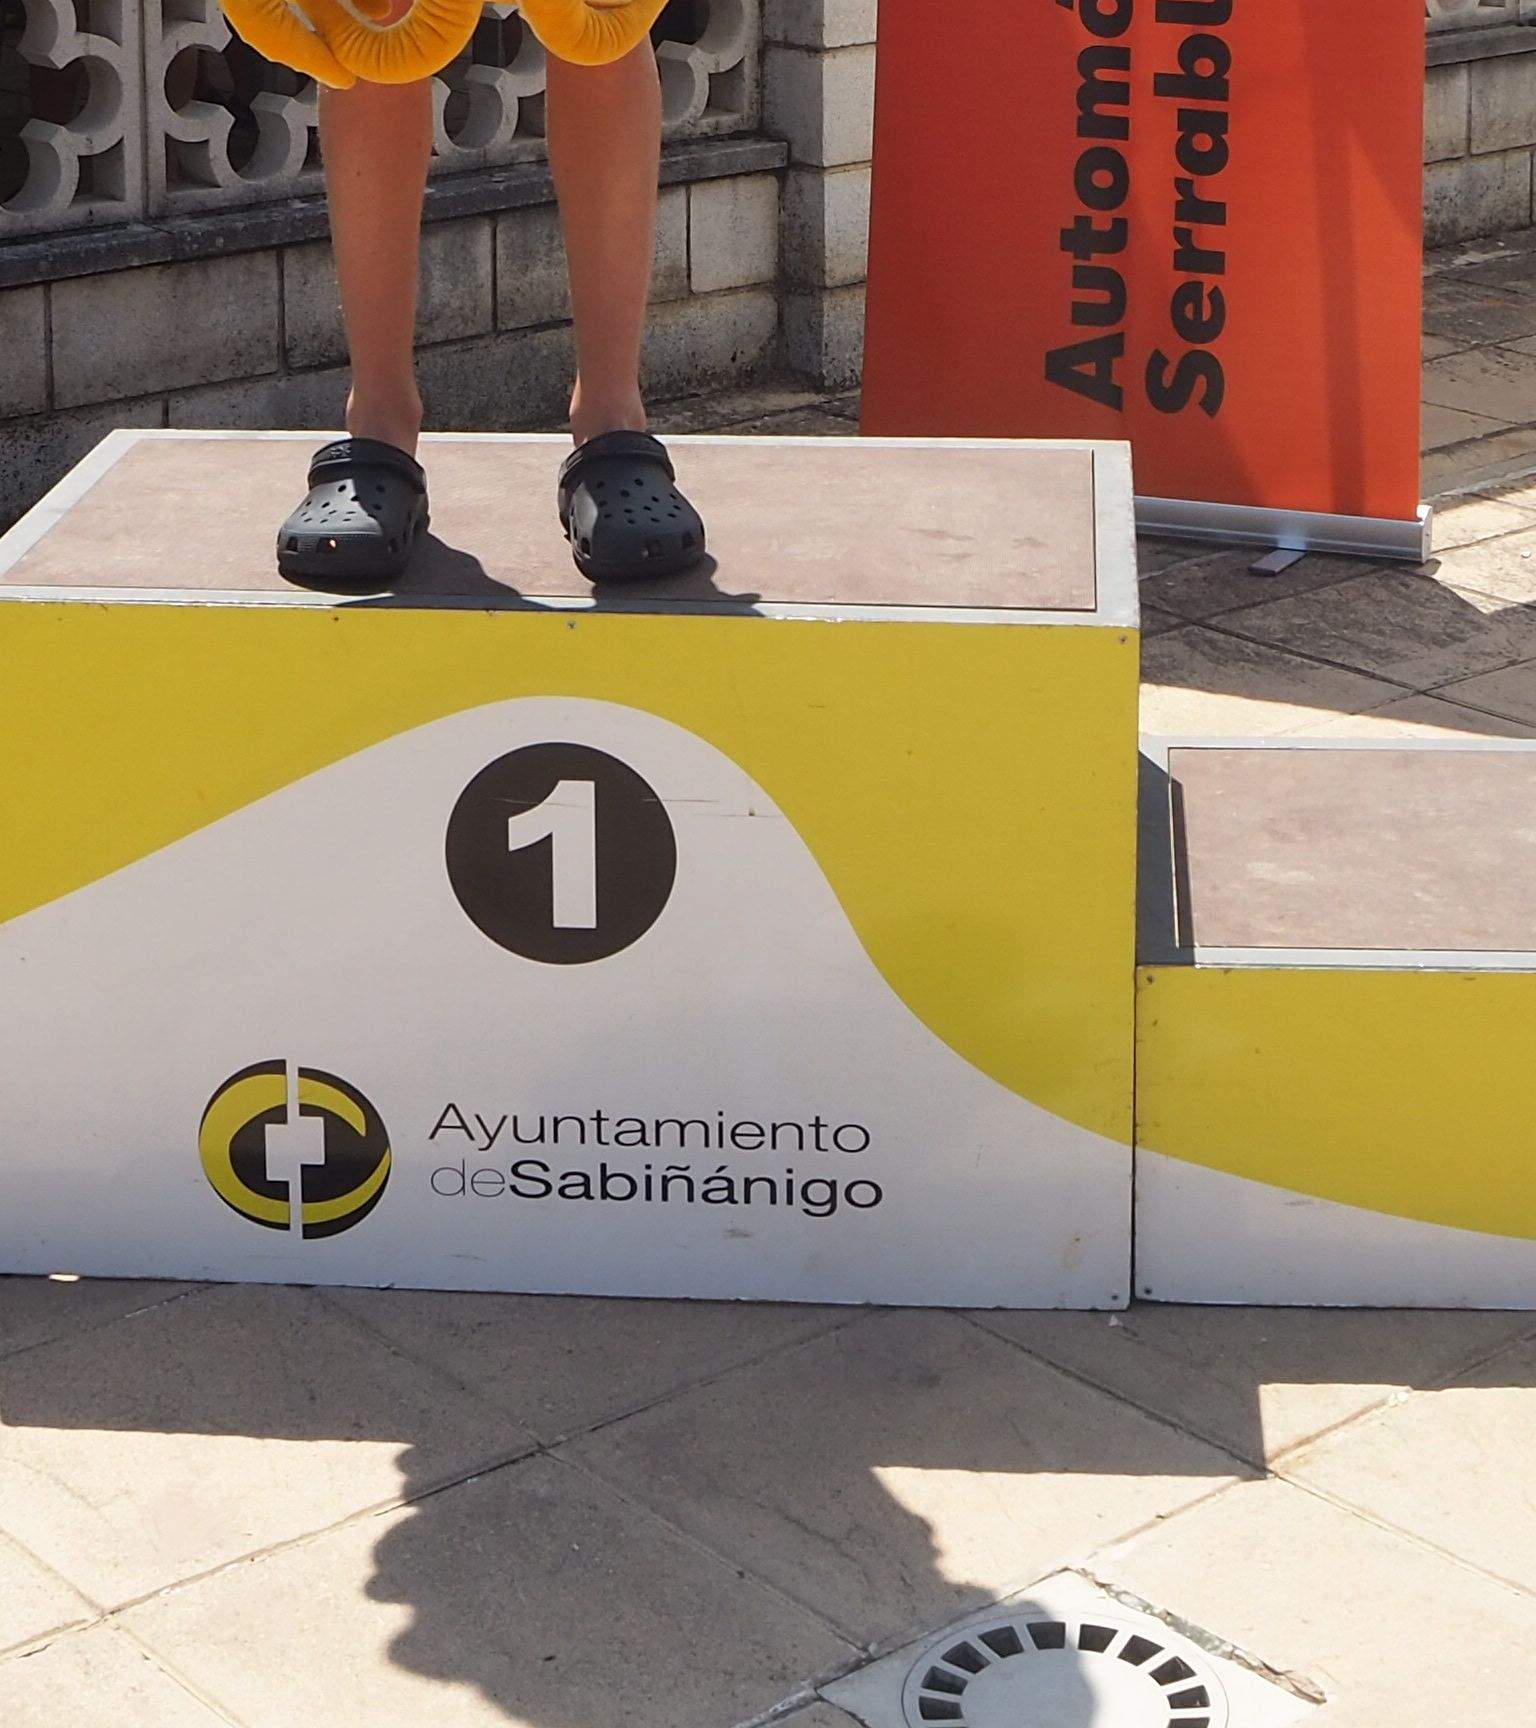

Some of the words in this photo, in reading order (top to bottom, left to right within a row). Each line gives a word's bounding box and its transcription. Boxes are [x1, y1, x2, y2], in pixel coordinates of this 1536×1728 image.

[507, 779, 597, 929] 1
[428, 1102, 872, 1153] Ayuntamiento
[430, 1158, 885, 1218] deSabiñánigo
